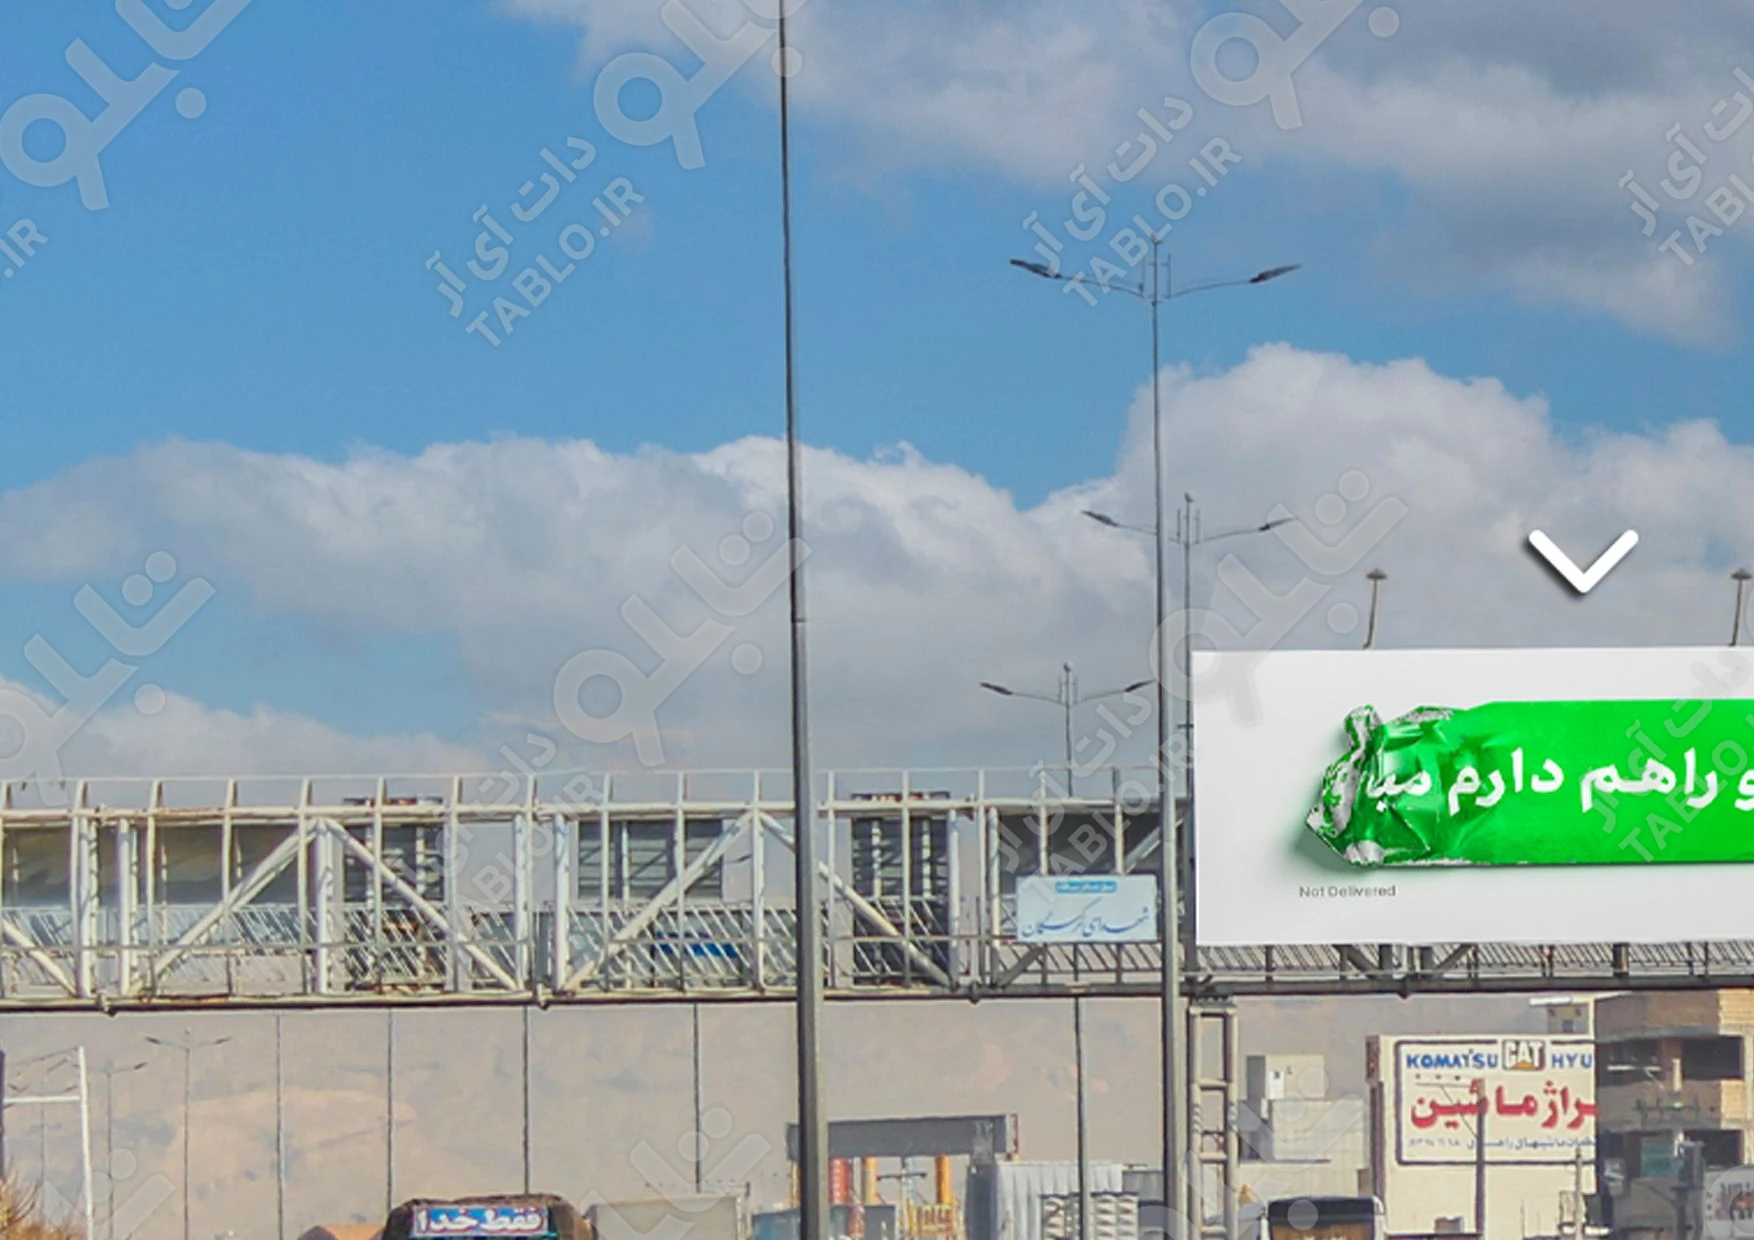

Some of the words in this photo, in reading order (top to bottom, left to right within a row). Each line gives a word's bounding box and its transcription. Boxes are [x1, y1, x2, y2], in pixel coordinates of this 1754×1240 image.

[1447, 749, 1564, 815] دارم
[1299, 884, 1325, 898] Not
[1328, 884, 1396, 898] Delivered
[1405, 1053, 1498, 1070] KOMATSU
[1504, 1040, 1543, 1070] CAT
[417, 1206, 478, 1232] خدا
[482, 1206, 544, 1232] فقط
